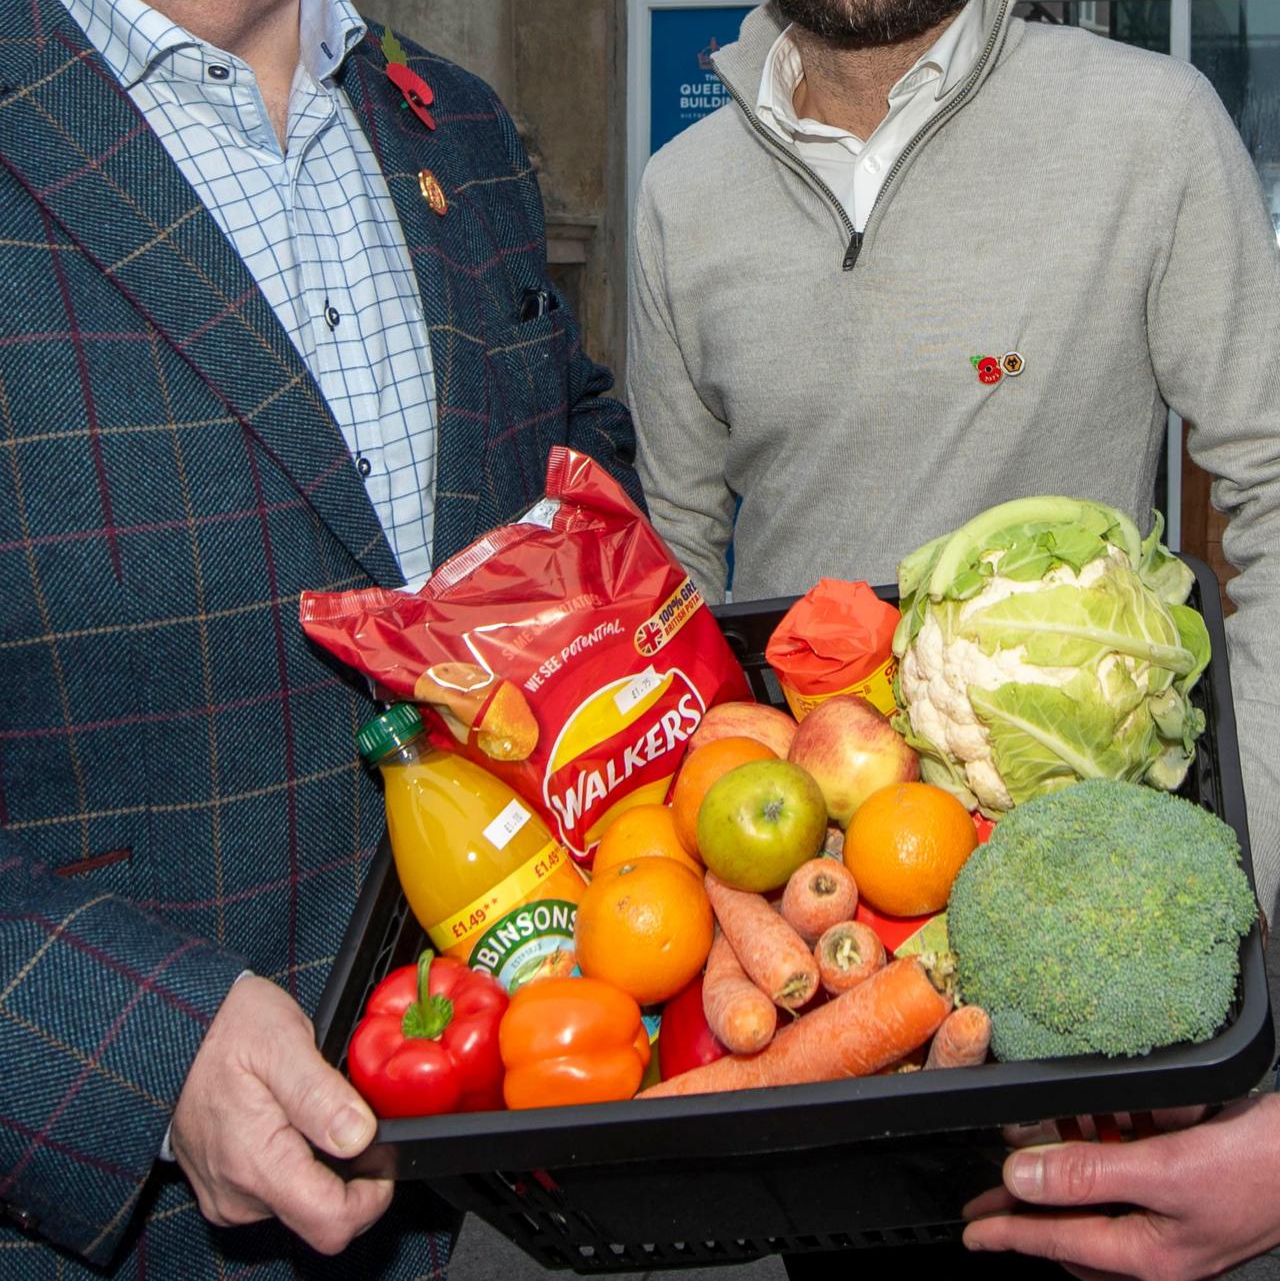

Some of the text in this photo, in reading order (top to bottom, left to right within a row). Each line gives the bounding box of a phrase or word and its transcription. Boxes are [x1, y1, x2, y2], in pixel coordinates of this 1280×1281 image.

[659, 596, 684, 626] 100%
[664, 606, 687, 636] BRITISH
[502, 629, 535, 661] SME
[524, 672, 545, 693] WE
[539, 656, 562, 678] SEE
[551, 693, 703, 830] WALKERS
